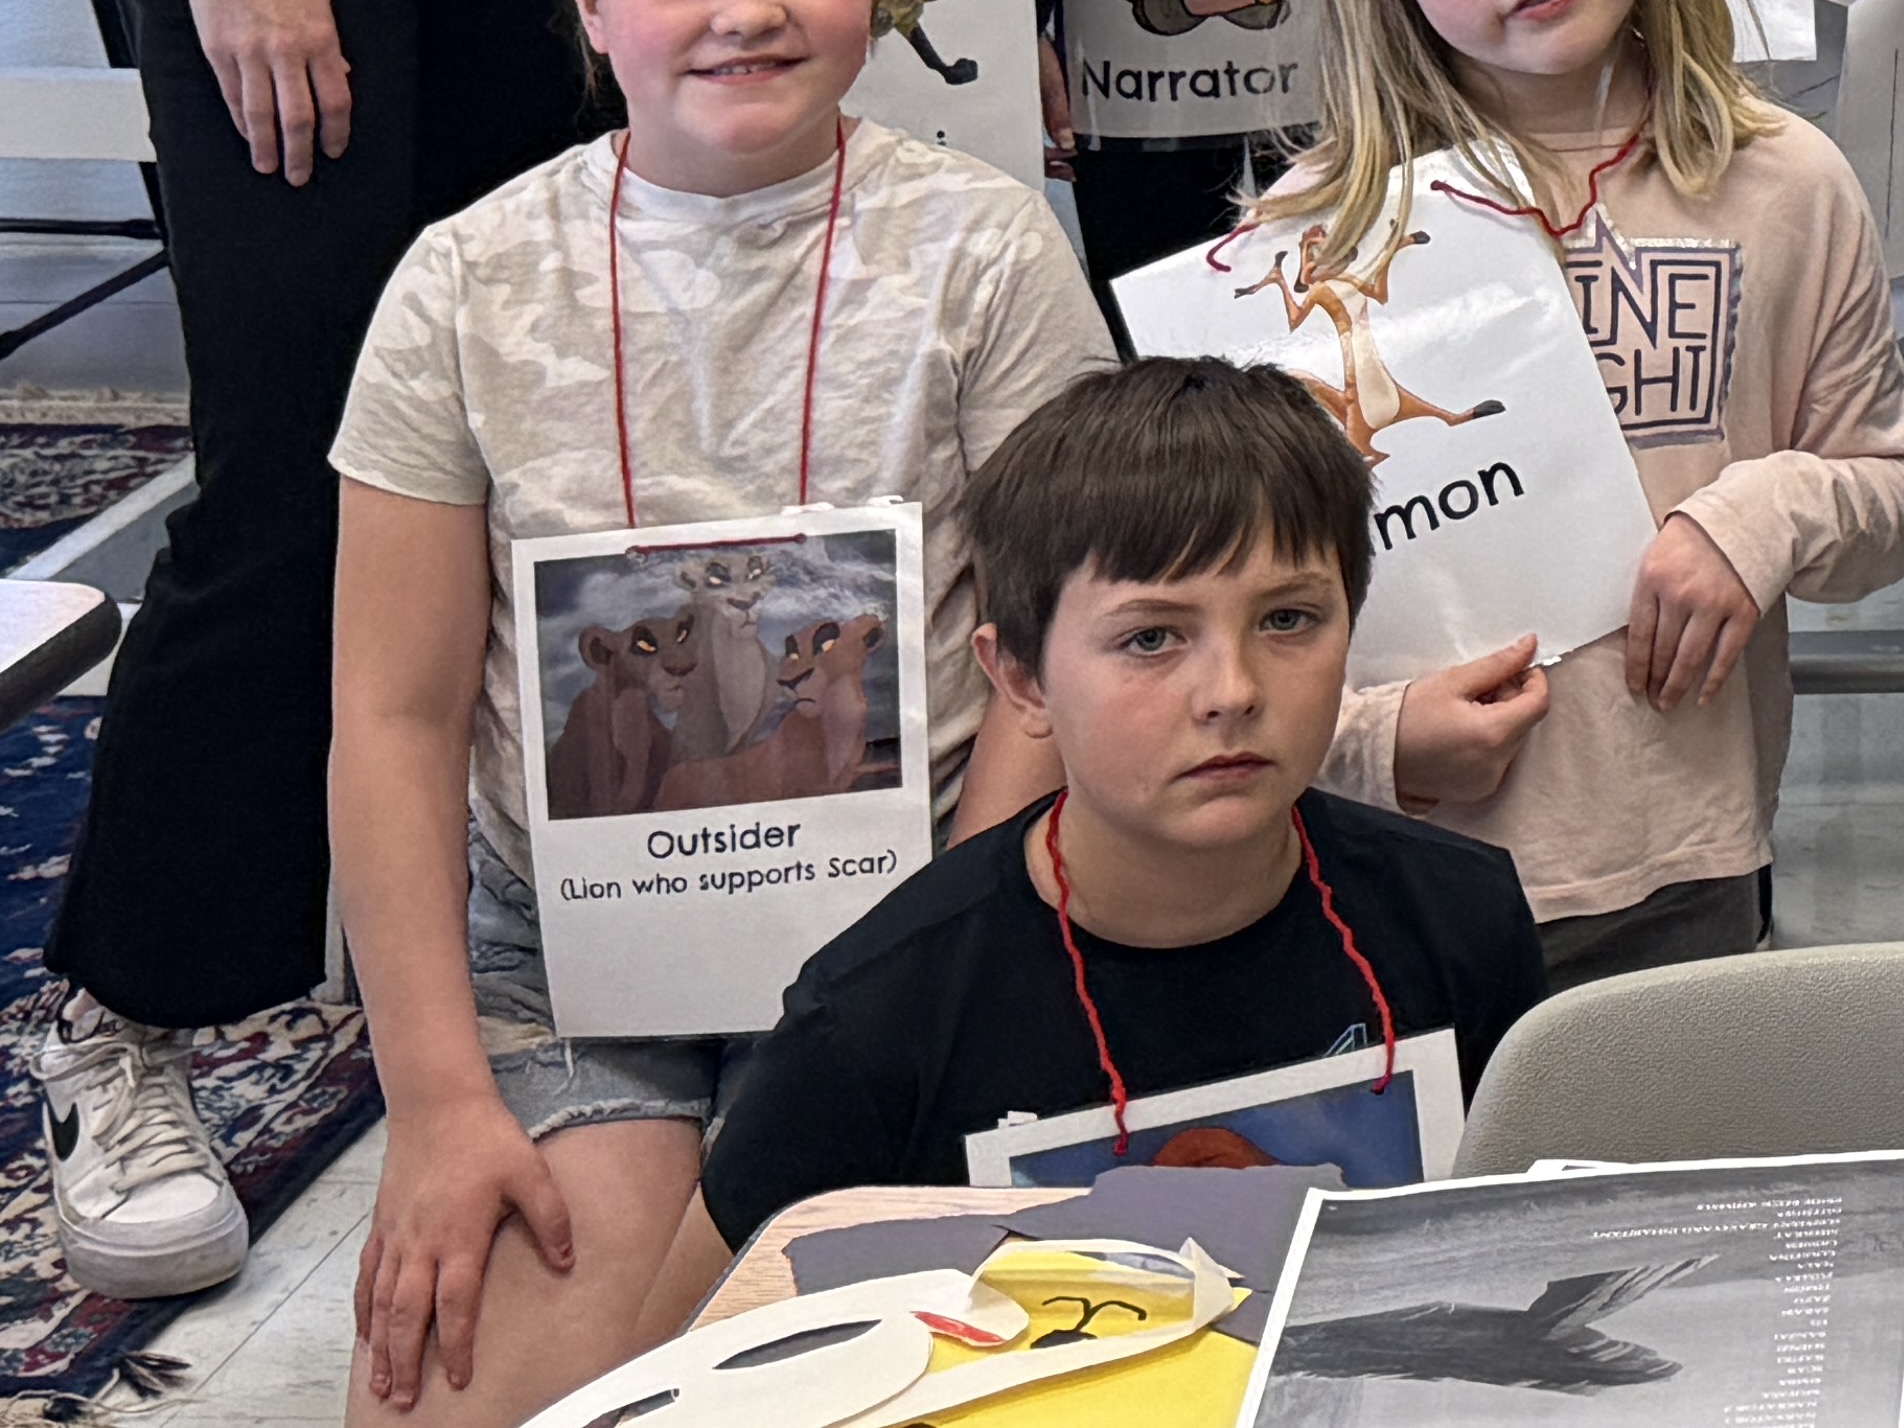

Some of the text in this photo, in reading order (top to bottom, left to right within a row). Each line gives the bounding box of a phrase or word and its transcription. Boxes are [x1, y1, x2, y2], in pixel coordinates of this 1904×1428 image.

[1081, 56, 1299, 104] Narrator
[1574, 261, 1710, 350] INE
[1594, 343, 1708, 417] GHT
[1374, 458, 1527, 552] mon
[646, 820, 801, 860] Outsider
[560, 848, 898, 903] (Lion who supports Scar)
